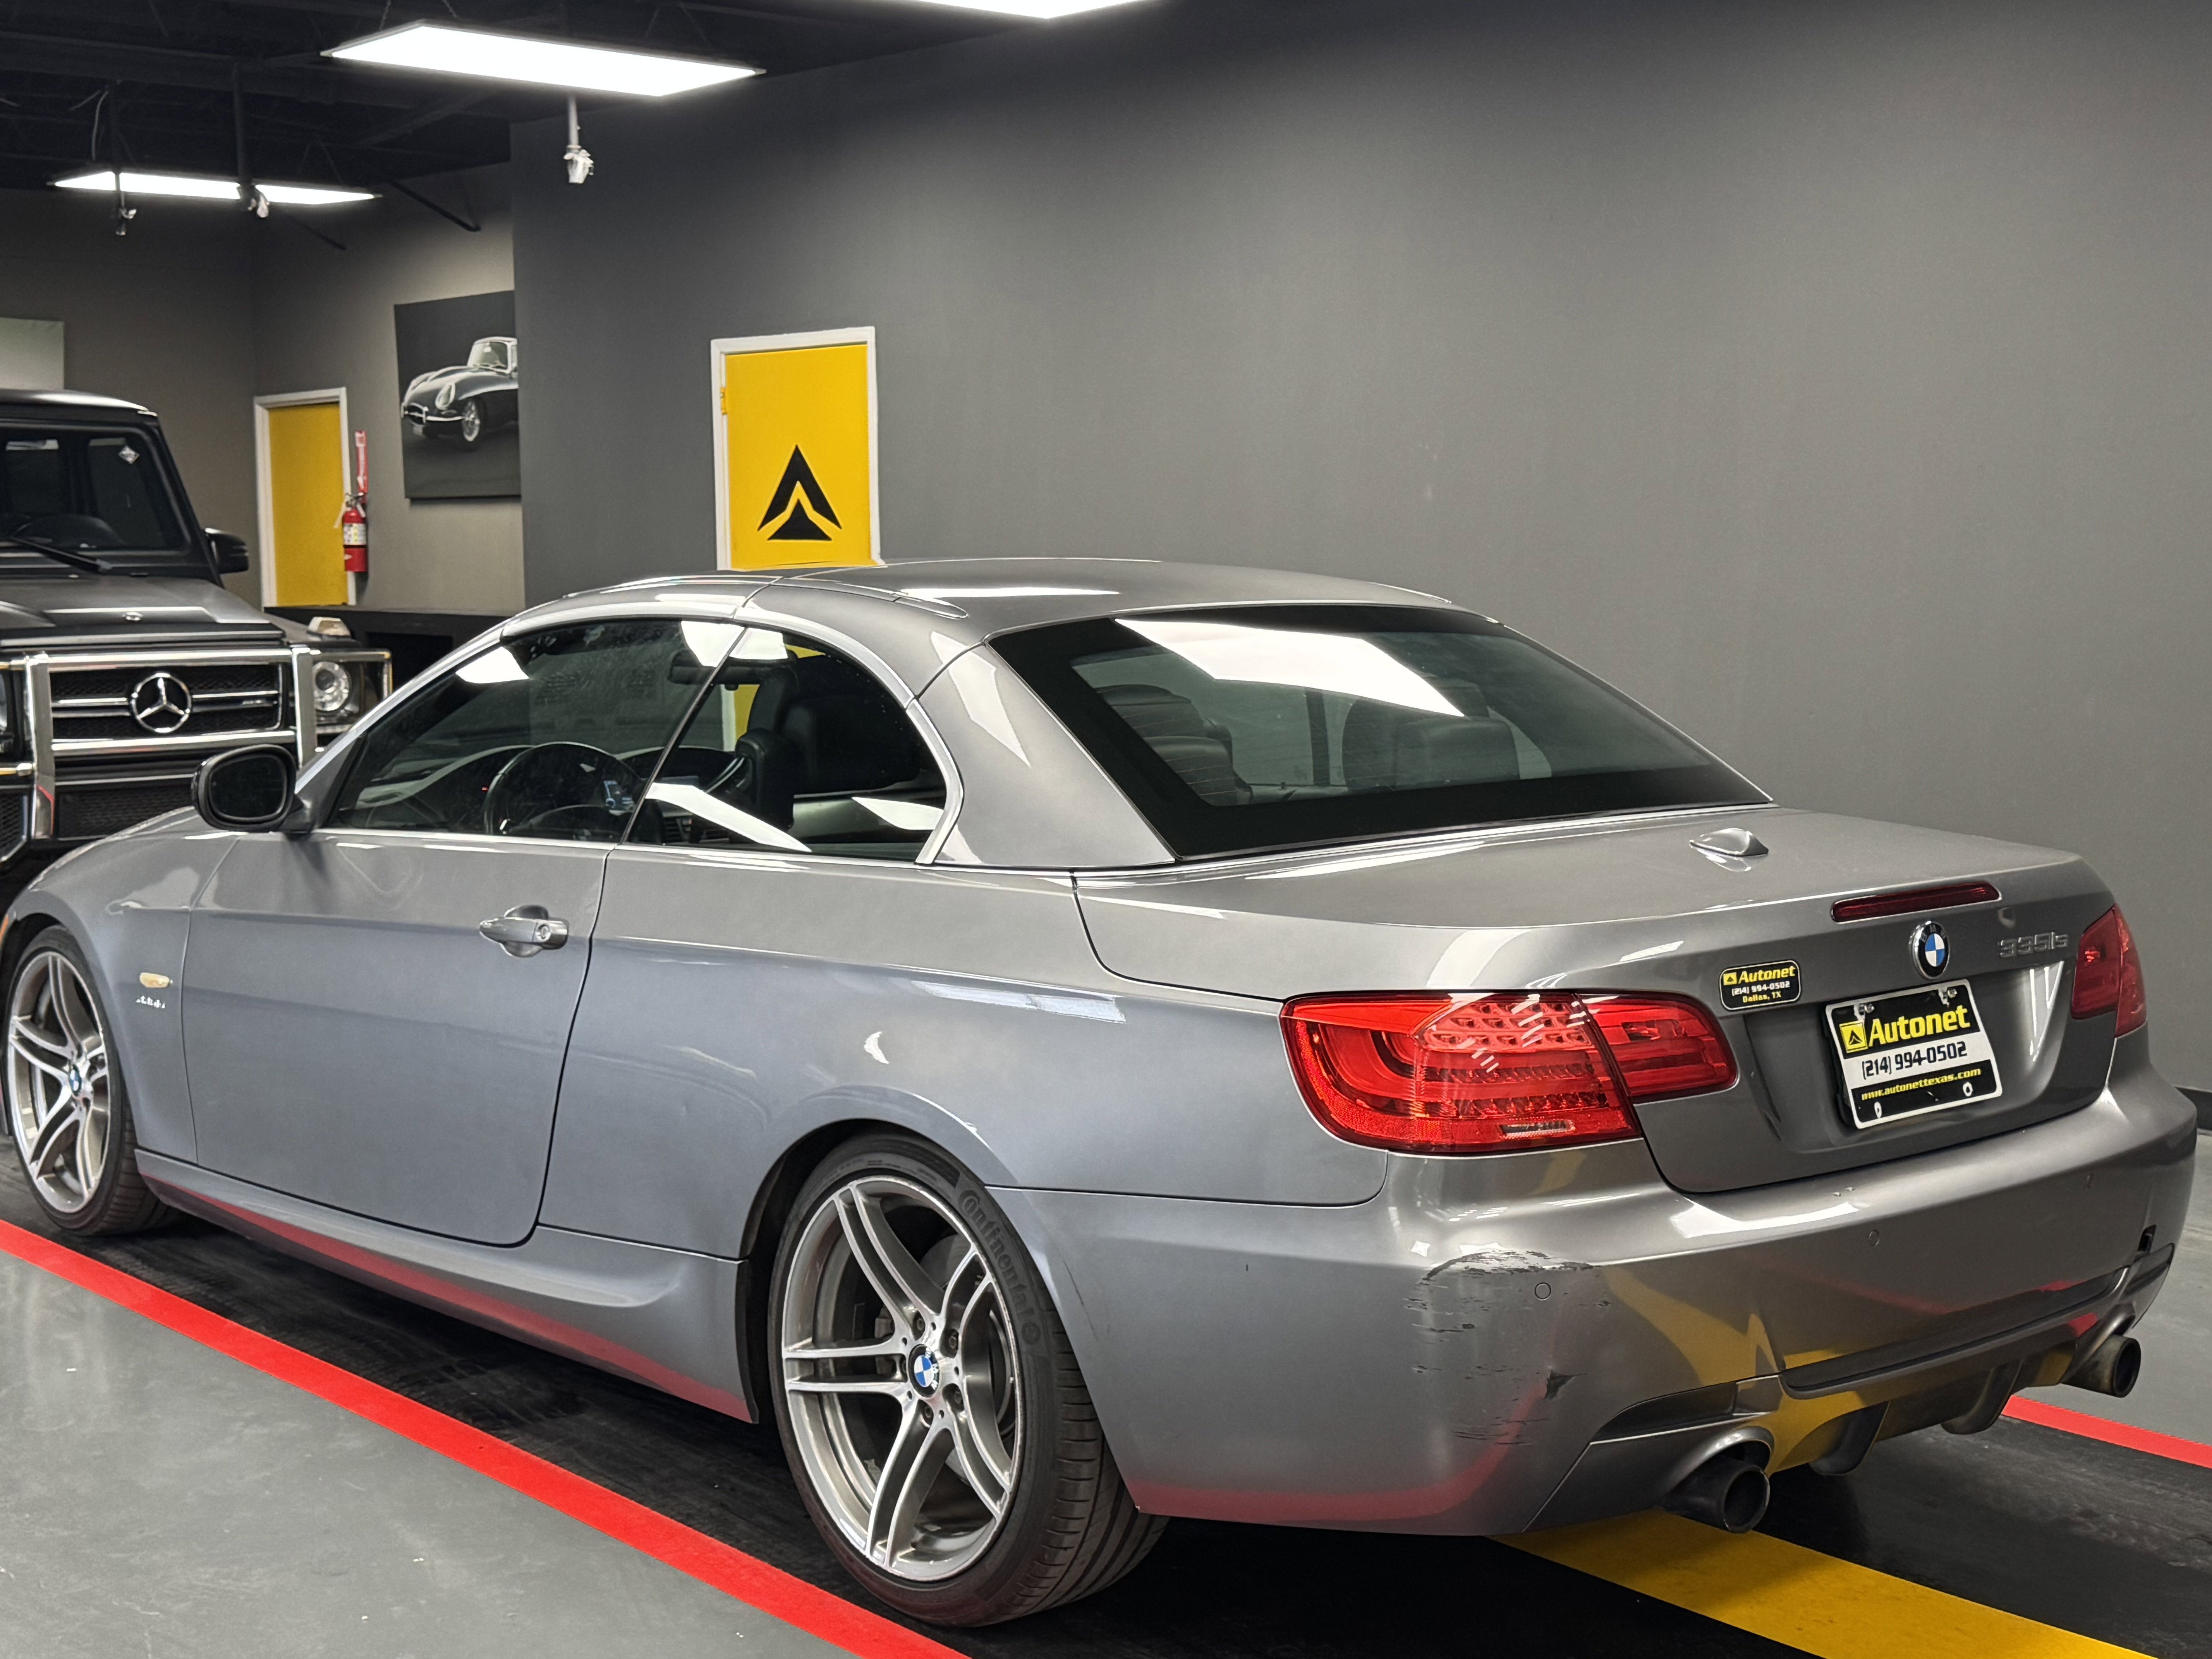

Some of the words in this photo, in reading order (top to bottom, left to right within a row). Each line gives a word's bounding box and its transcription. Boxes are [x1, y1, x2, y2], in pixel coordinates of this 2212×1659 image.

[1738, 966, 1795, 984] Autonet
[1732, 986, 1749, 996] (214)
[1752, 981, 1790, 993] 994-0502
[1743, 994, 1770, 1003] Dallas,
[1869, 1005, 1970, 1047] Autonet
[1862, 1056, 1891, 1080] (214)
[1895, 1041, 1967, 1070] 994-0502
[1862, 1068, 1981, 1101] www.autonettexas.com
